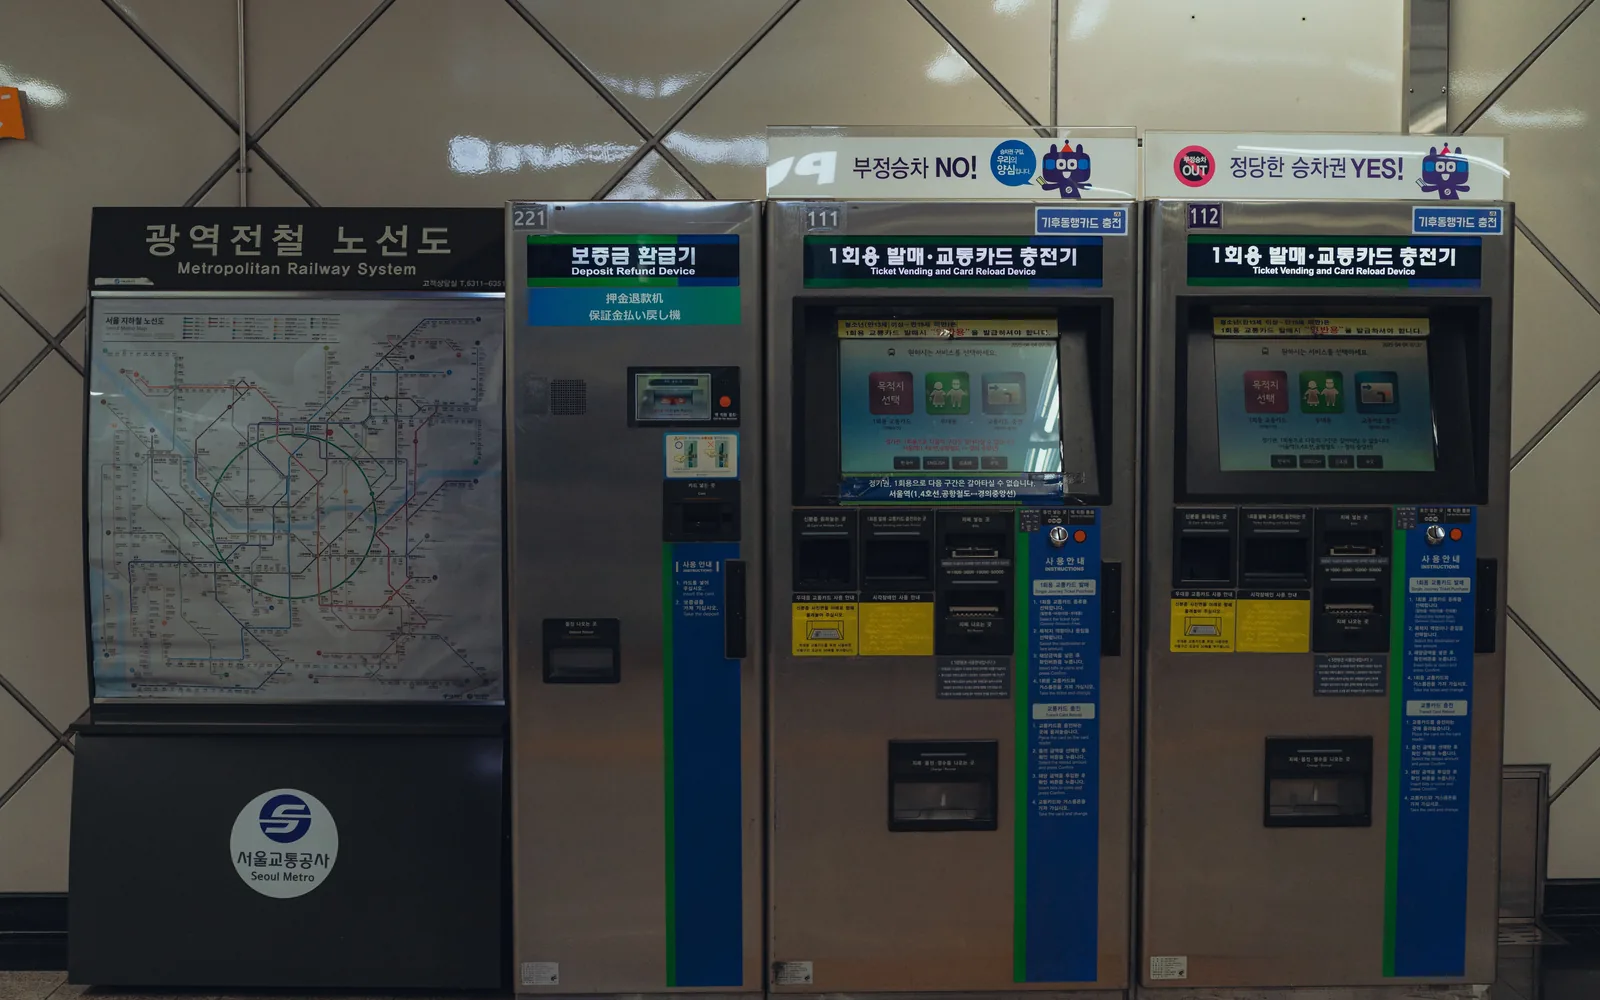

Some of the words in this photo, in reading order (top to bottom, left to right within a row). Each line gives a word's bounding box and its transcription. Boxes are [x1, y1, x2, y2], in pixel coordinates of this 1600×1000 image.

[997, 155, 1017, 164] 우리의
[852, 156, 929, 180] 부정승차
[935, 155, 977, 180] NO!
[997, 164, 1031, 175] 양심입니다.
[1182, 164, 1208, 177] OUT
[1230, 156, 1285, 179] 정당한
[1291, 156, 1347, 179] 승차권
[1351, 158, 1403, 180] YES!
[514, 211, 546, 226] 221
[808, 211, 838, 226] 111
[1191, 207, 1219, 225] 112
[1418, 216, 1475, 228] 기후동행카드
[1478, 216, 1497, 228] 충전
[1042, 217, 1099, 229] 기후동행카드
[1102, 217, 1122, 229] 충전
[146, 224, 305, 256] 광역전철
[333, 224, 452, 256] 노선도
[572, 247, 630, 265] 보증금
[638, 247, 696, 265] 환급기
[829, 246, 881, 266] 1회용
[887, 246, 1013, 266] 발매·교통카드
[1020, 246, 1077, 267] 충전기
[1212, 245, 1262, 266] 1회용
[1269, 246, 1394, 266] 발매·교통카드
[1399, 246, 1456, 267] 충전기
[177, 262, 280, 277] Metropolitan
[288, 262, 350, 277] Railway
[358, 262, 417, 277] System
[571, 267, 613, 277] Deposit
[616, 267, 655, 276] Refund
[659, 267, 695, 276] Device
[871, 267, 897, 276] Ticket
[899, 267, 933, 277] Vending
[935, 267, 951, 276] and
[953, 267, 974, 276] Card
[976, 267, 1005, 276] Reload
[1008, 267, 1036, 276] Device
[1253, 266, 1279, 276] Ticket
[1281, 266, 1314, 277] Vending
[1316, 266, 1332, 276] and
[1334, 266, 1355, 276] Card
[1356, 266, 1385, 276] Reload
[1387, 266, 1416, 276] Device
[606, 293, 664, 304] 押金退款机
[589, 309, 681, 321] 保証金払い戻し機
[877, 382, 904, 392] 목적지
[1252, 379, 1279, 390] 목적지
[881, 396, 901, 406] 선택
[1257, 394, 1275, 404] 선택
[894, 479, 926, 487] 1회용으로
[929, 479, 942, 488] 다음
[944, 479, 965, 488] 구간은
[967, 479, 995, 488] 갈아타실
[997, 479, 1004, 488] 수
[1046, 556, 1085, 566] 사용안내
[1422, 554, 1460, 564] 사용안내
[237, 851, 330, 869] 서울교통공사
[251, 871, 279, 881] Seoul
[284, 872, 314, 882] Metro
